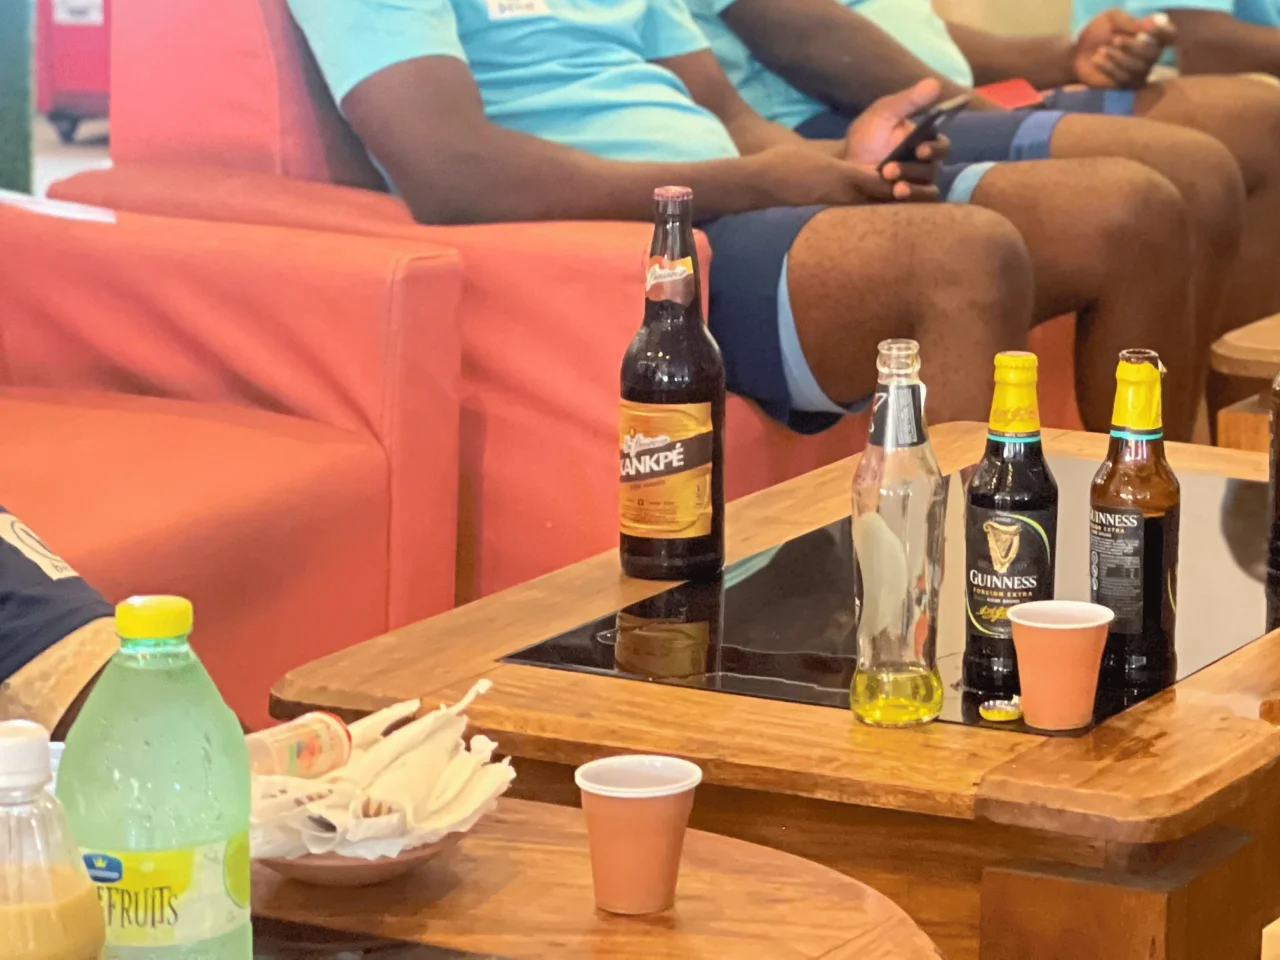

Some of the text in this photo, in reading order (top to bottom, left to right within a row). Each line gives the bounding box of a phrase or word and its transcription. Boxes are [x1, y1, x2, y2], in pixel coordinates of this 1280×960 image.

[1090, 508, 1138, 528] UINNESS
[969, 569, 1037, 589] GUINNESS
[1007, 590, 1032, 598] EXTRA
